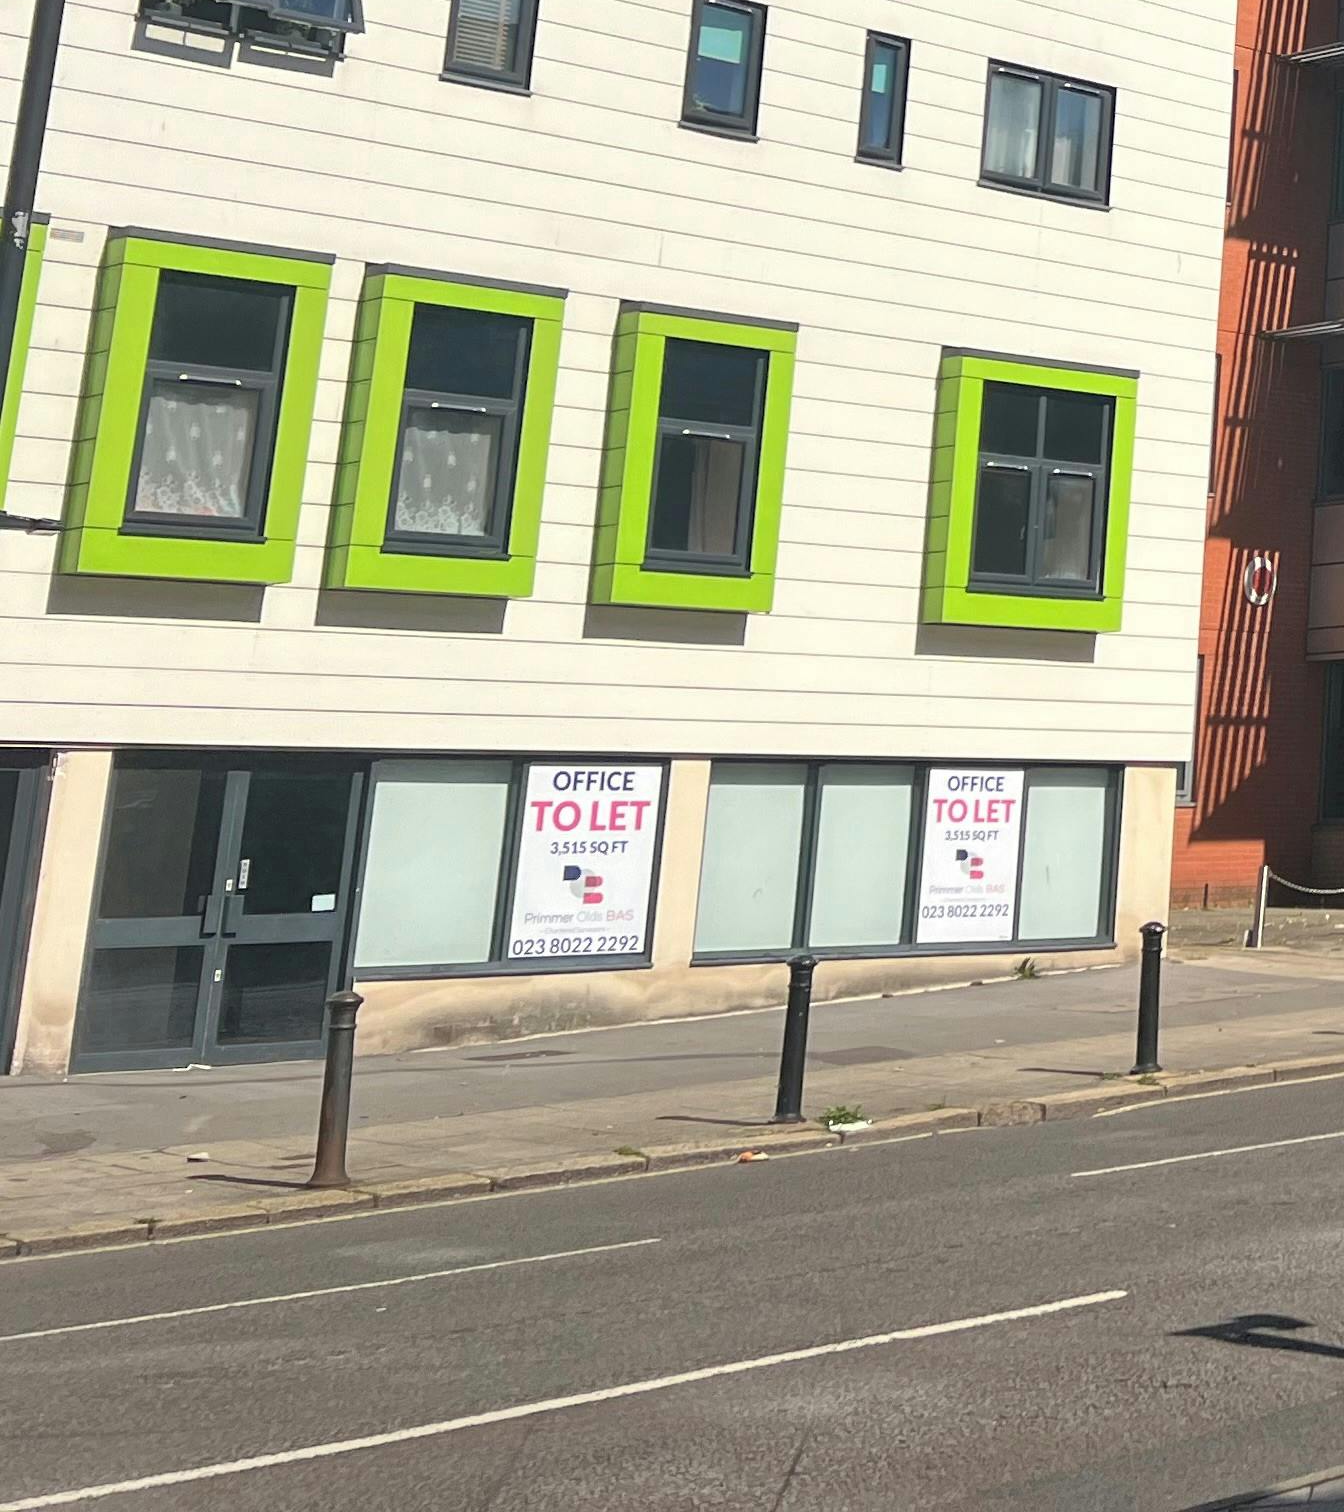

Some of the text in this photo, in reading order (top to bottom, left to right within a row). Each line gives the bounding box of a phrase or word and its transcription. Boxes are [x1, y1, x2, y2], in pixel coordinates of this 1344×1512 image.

[553, 771, 635, 791] OFFICE
[947, 776, 1005, 792] OFFICE
[530, 800, 652, 831] TO LET
[933, 798, 1016, 823] TO LET
[972, 830, 986, 841] SQ
[987, 830, 999, 840] FT
[550, 840, 628, 855] 3,515 SQ FT
[524, 912, 574, 924] Primmer
[606, 909, 634, 922] BAS
[921, 903, 1009, 919] 023 8022 2292
[512, 935, 639, 955] 023 8022 2292
